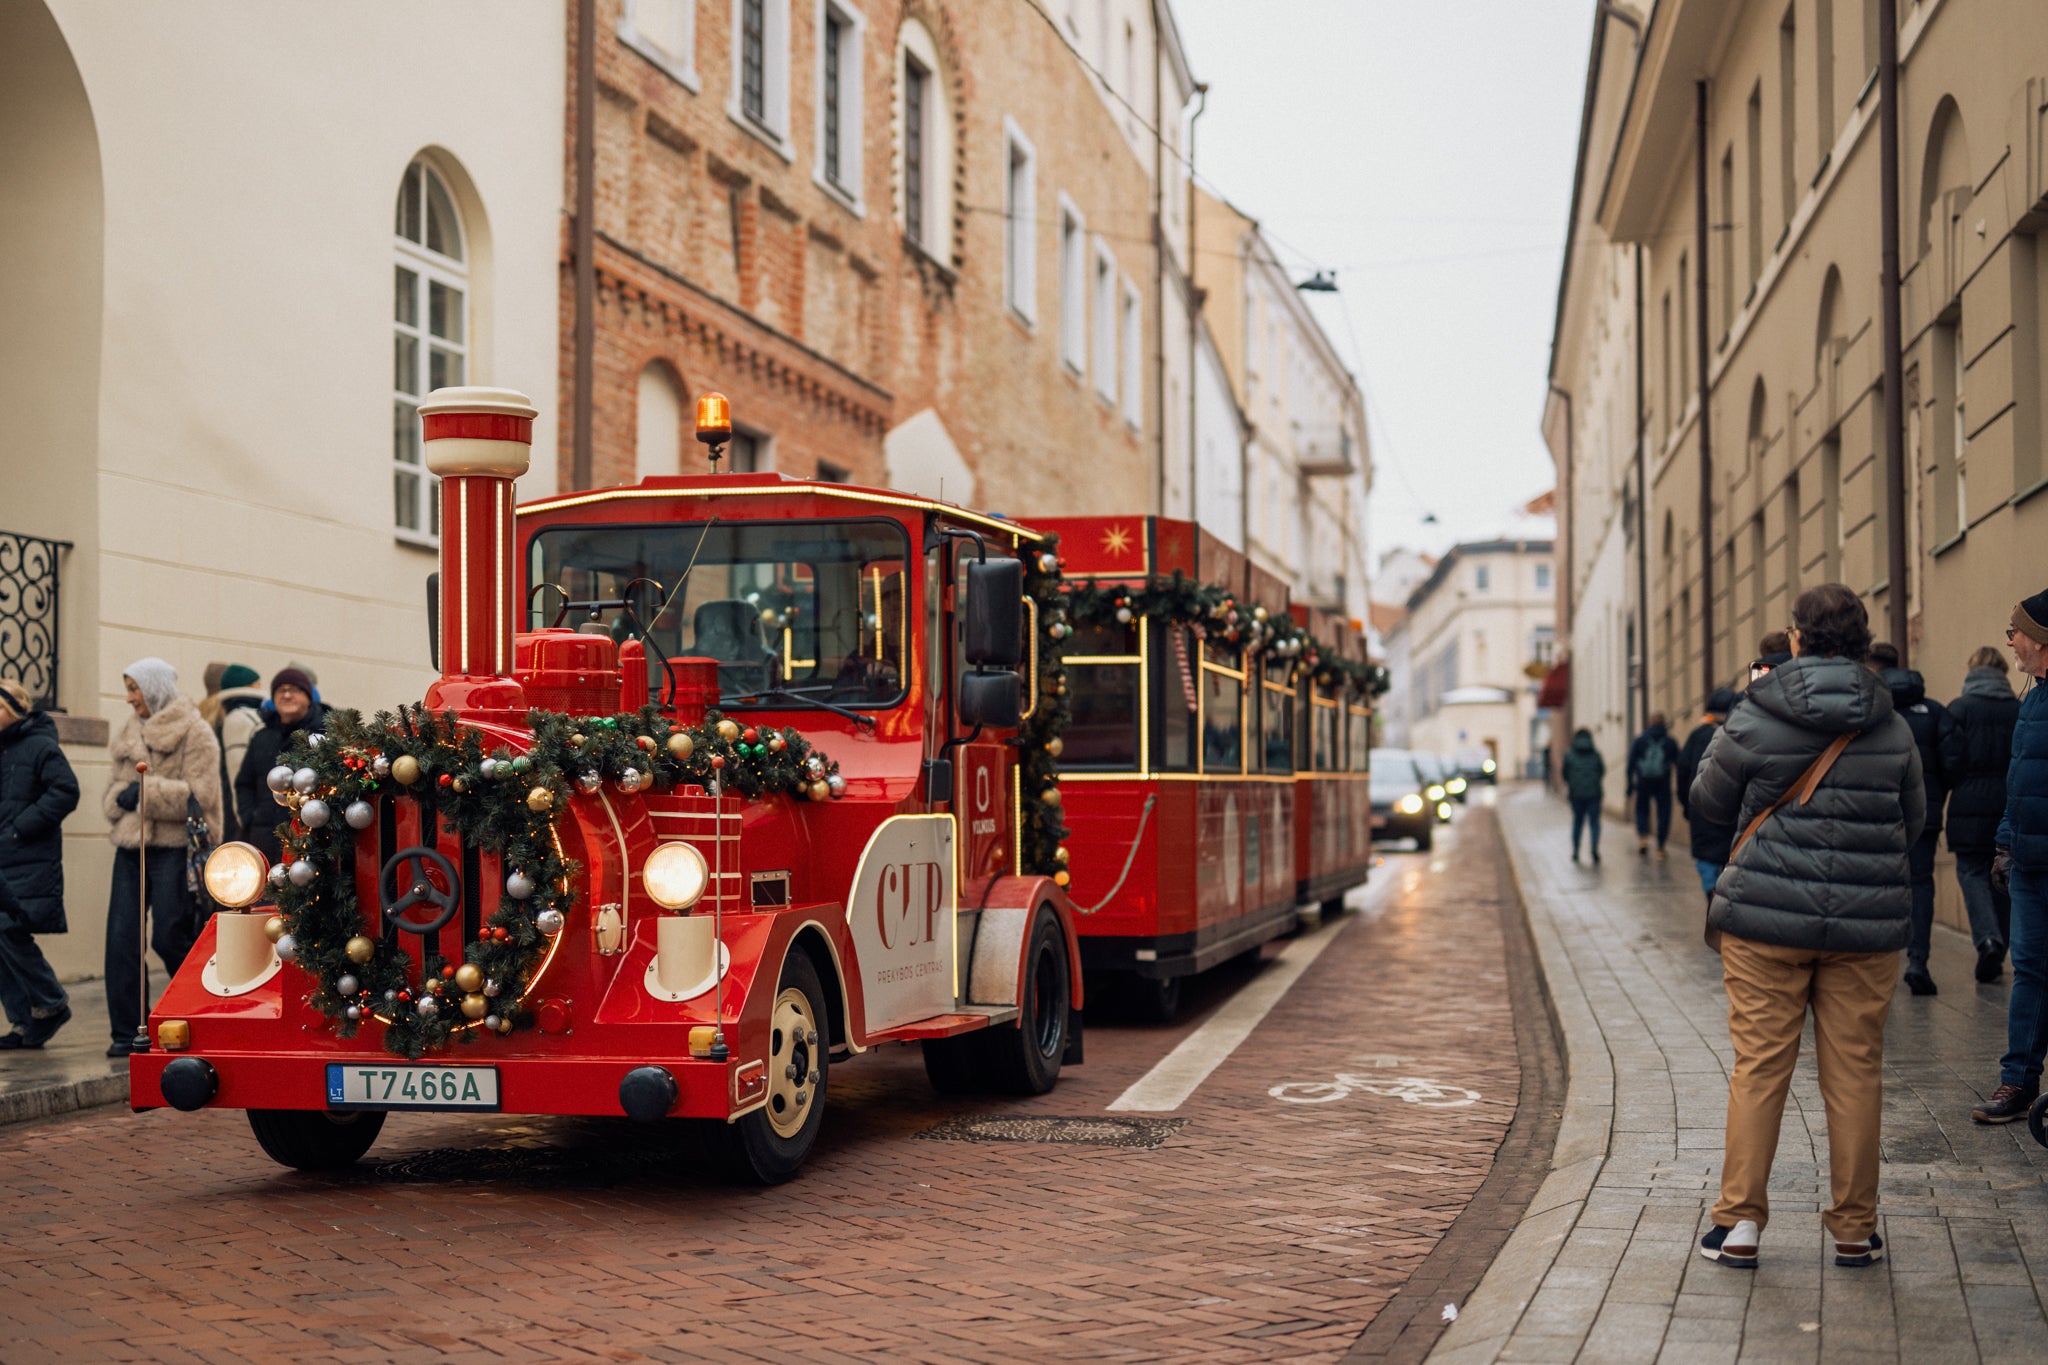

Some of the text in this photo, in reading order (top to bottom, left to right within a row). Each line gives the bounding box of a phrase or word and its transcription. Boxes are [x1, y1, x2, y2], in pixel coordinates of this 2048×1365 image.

[876, 861, 943, 950] CUP
[877, 959, 943, 984] PREKYBOS CENTRAS
[330, 1087, 343, 1097] LT
[358, 1070, 481, 1101] T7466A
